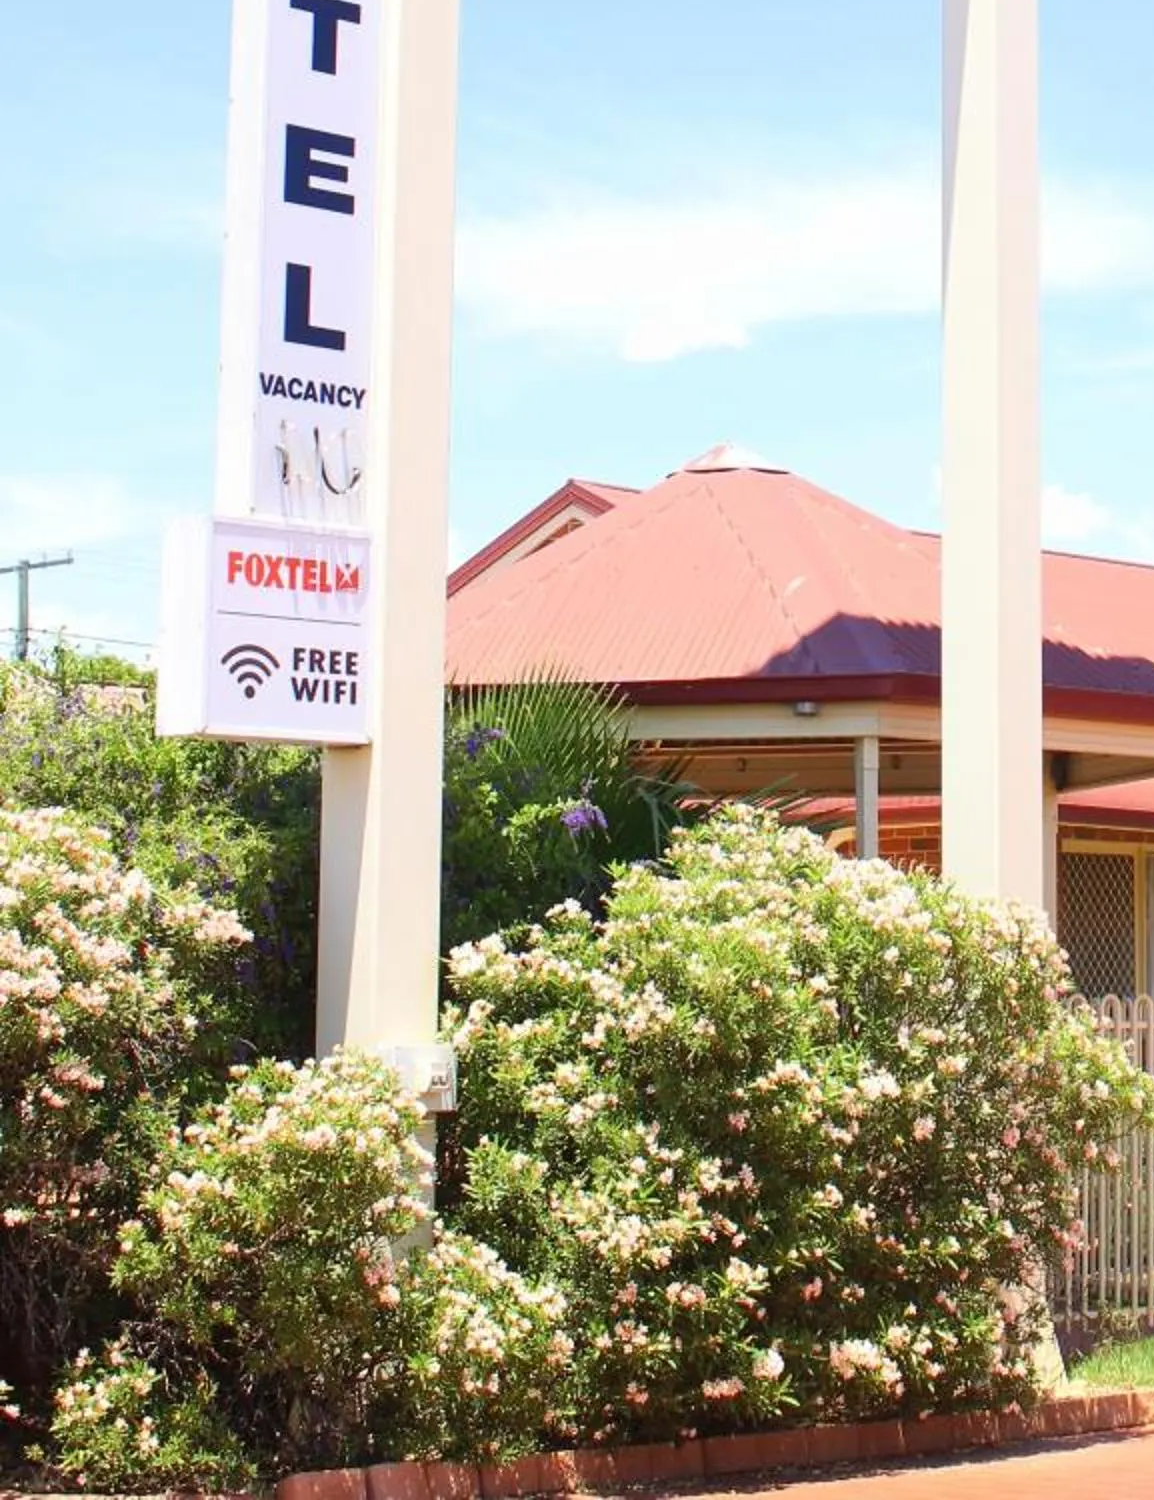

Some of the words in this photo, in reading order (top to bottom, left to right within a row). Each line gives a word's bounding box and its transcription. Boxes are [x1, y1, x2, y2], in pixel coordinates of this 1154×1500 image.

[259, 372, 367, 410] VACANCY
[227, 551, 332, 593] FOXTEL
[293, 647, 359, 676] FREE
[291, 676, 357, 705] WIFI
